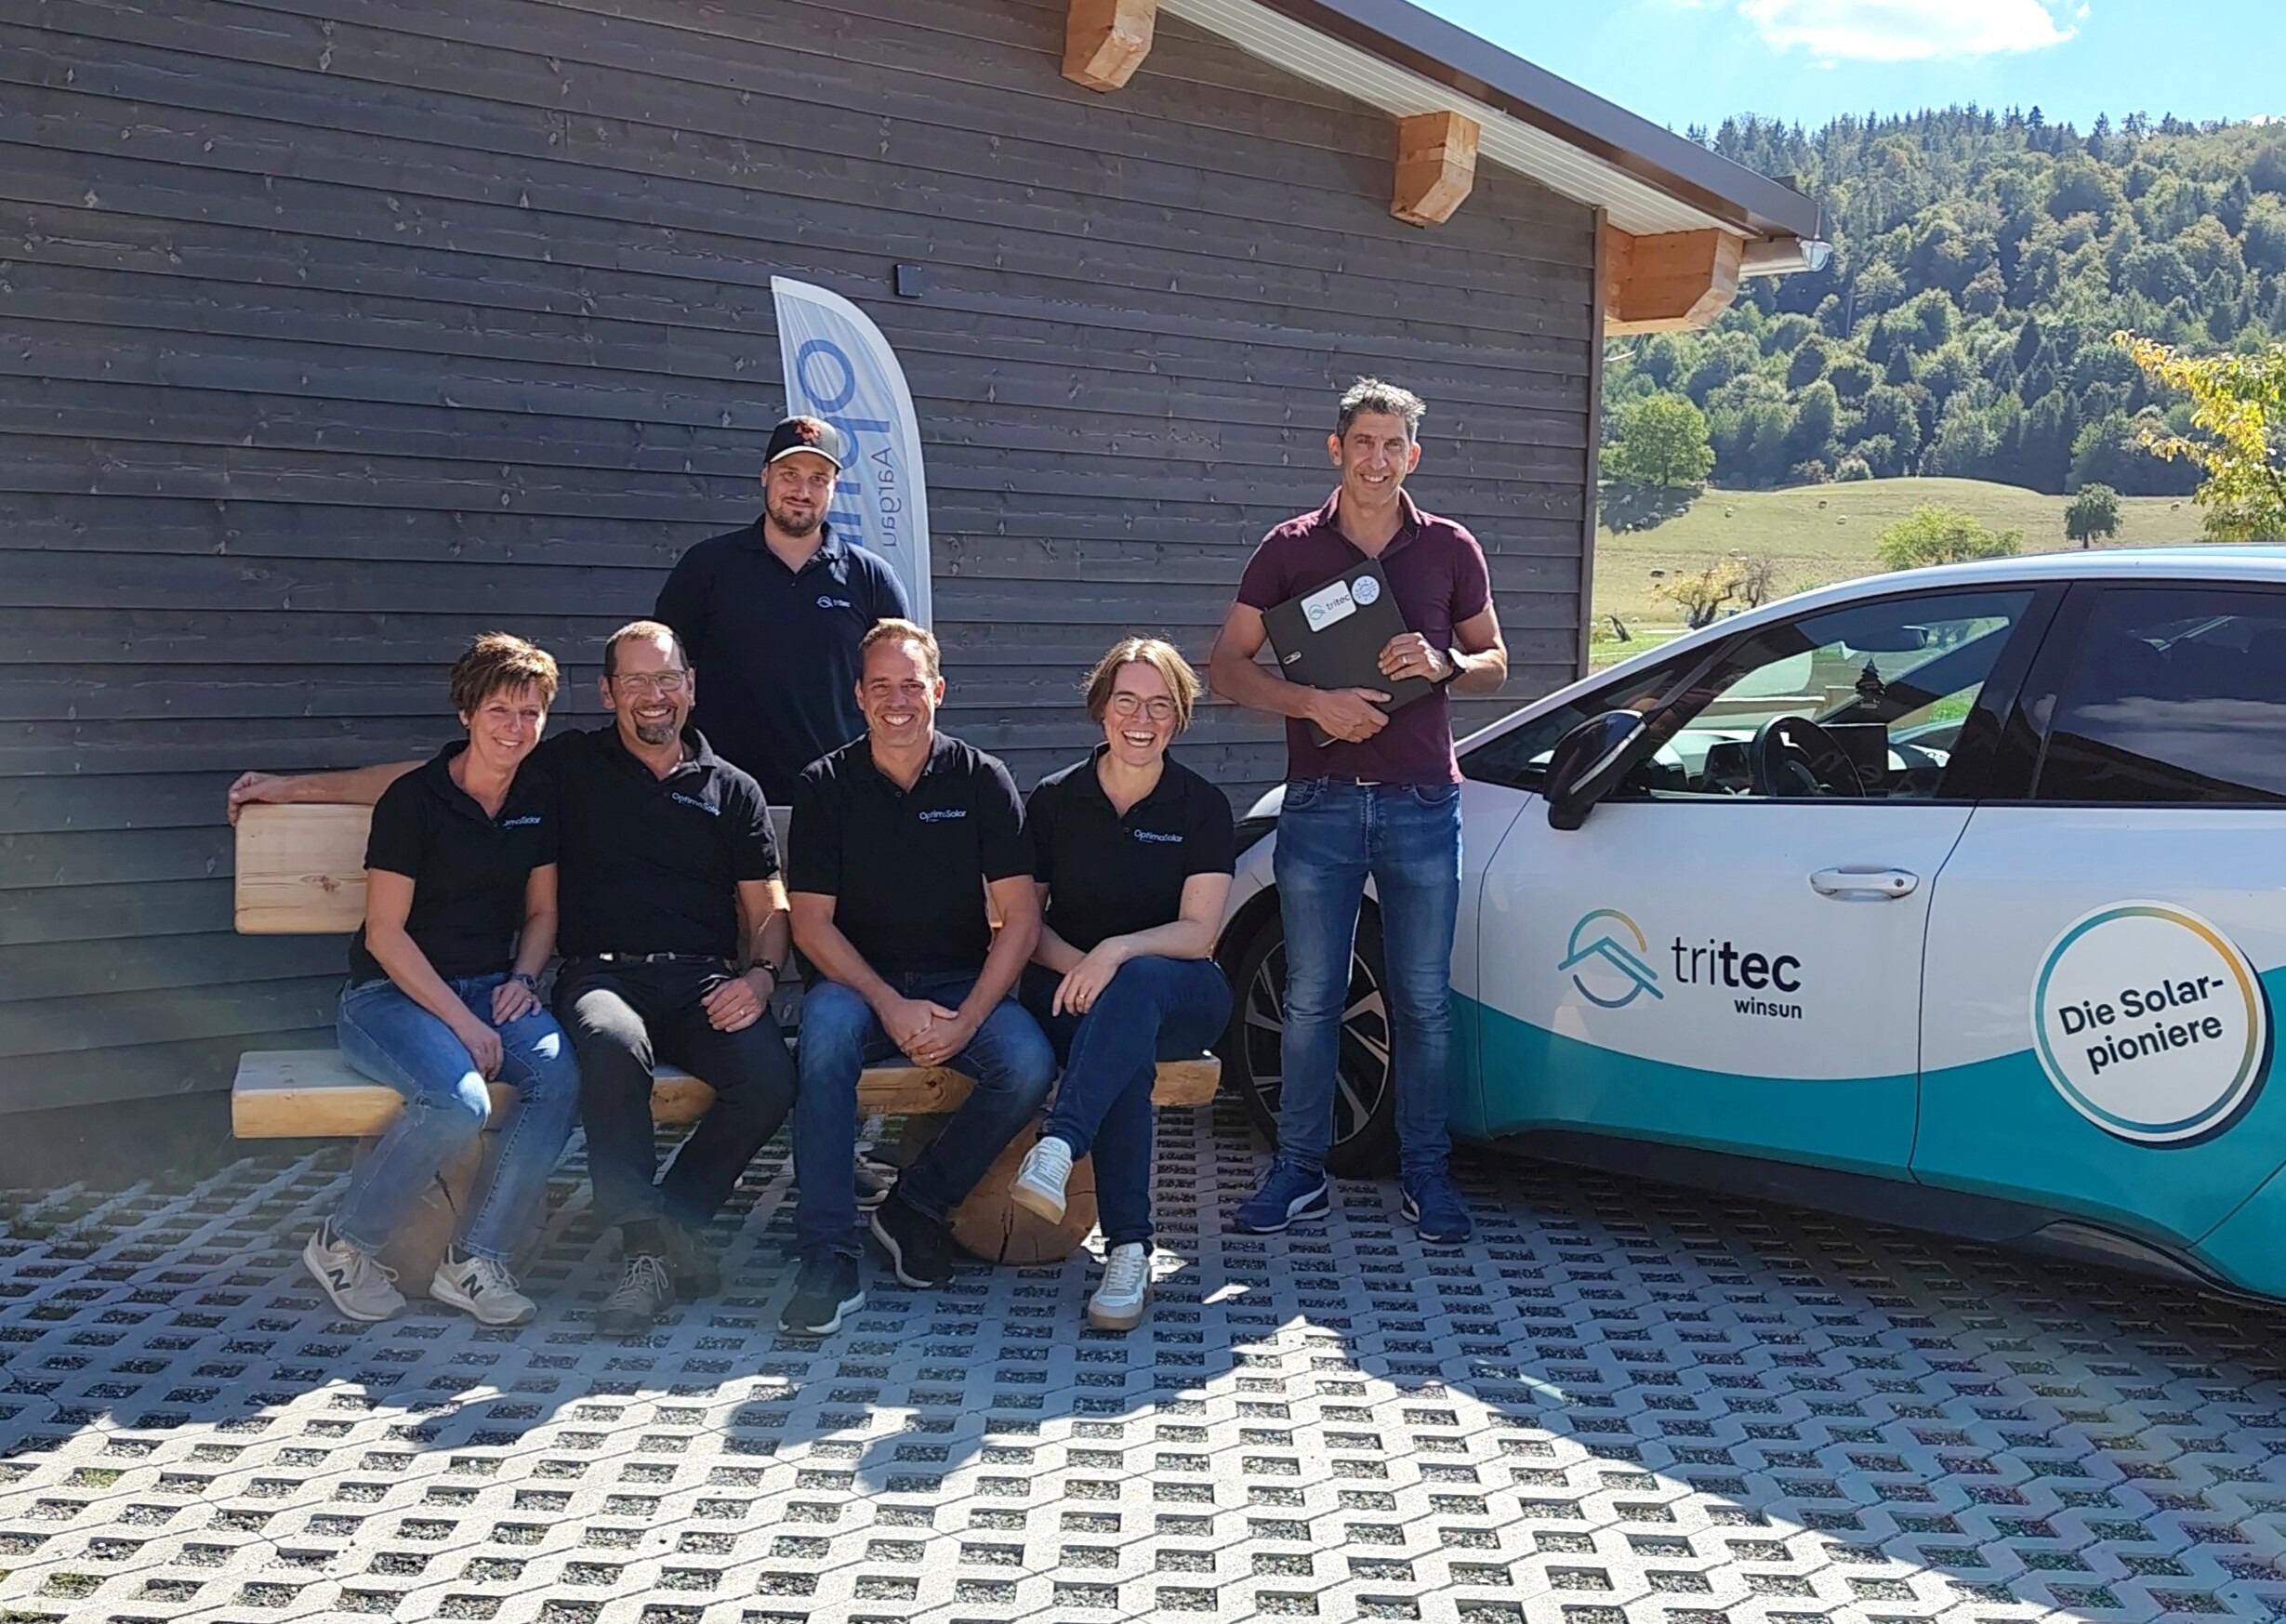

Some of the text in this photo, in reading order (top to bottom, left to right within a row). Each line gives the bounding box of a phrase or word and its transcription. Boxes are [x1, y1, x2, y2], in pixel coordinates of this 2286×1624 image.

[1326, 593, 1351, 611] tritec
[918, 810, 967, 823] OptimaSolar
[1672, 936, 1802, 993] tritec
[1734, 997, 1803, 1019] winsun
[2058, 976, 2224, 1036] Die Solar-
[2086, 1016, 2223, 1075] pioniere
